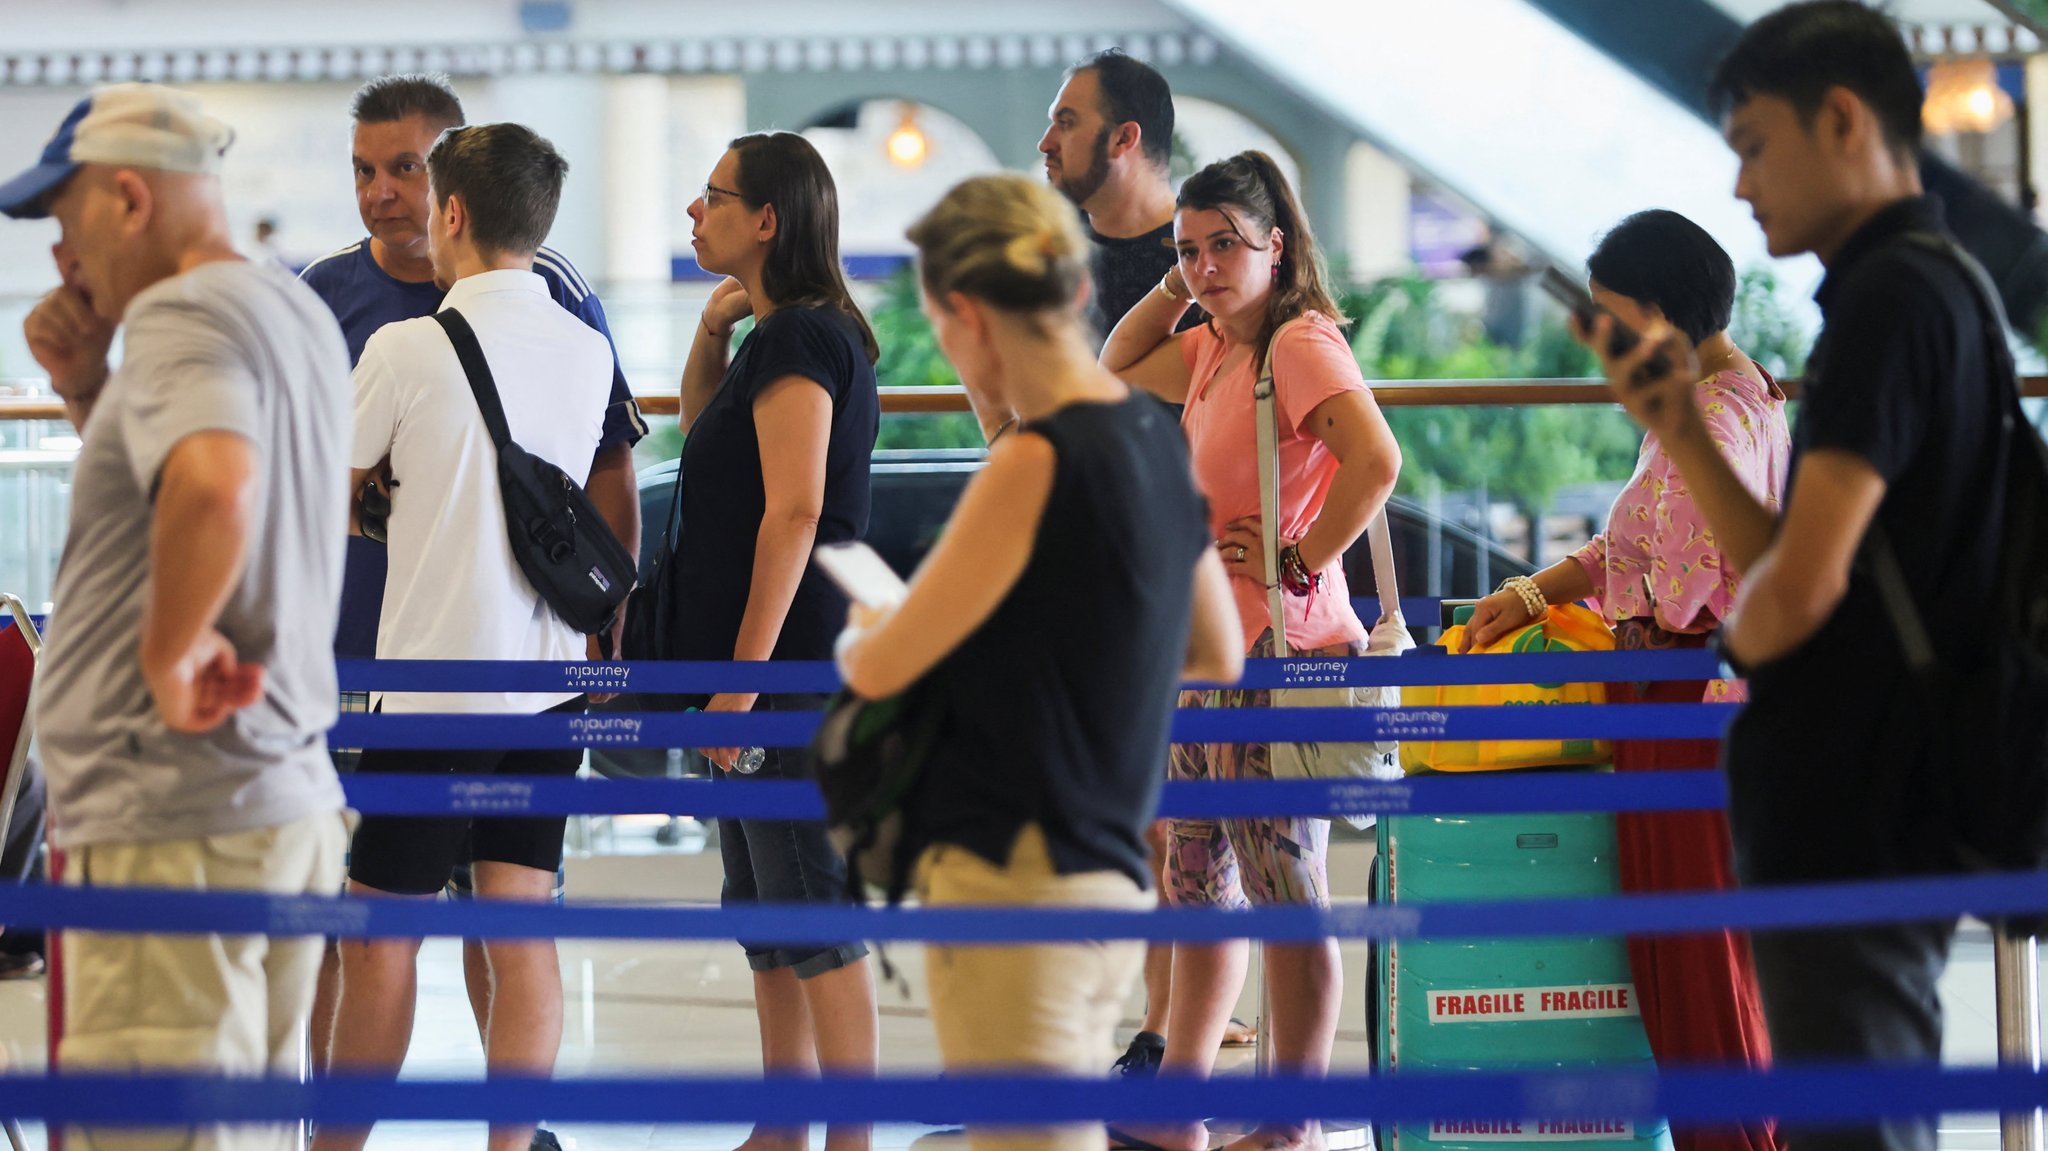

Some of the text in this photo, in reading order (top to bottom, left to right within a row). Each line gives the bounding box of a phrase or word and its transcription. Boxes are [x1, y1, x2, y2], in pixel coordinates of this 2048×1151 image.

[565, 666, 630, 680] injourney
[1283, 662, 1349, 675] injourney
[1285, 675, 1346, 683] AIRPORTS
[571, 734, 640, 742] AIRPORTS
[1435, 989, 1629, 1016] FRAGILE FRAGILE
[1433, 1117, 1625, 1134] FRAGILE FRAGILE
